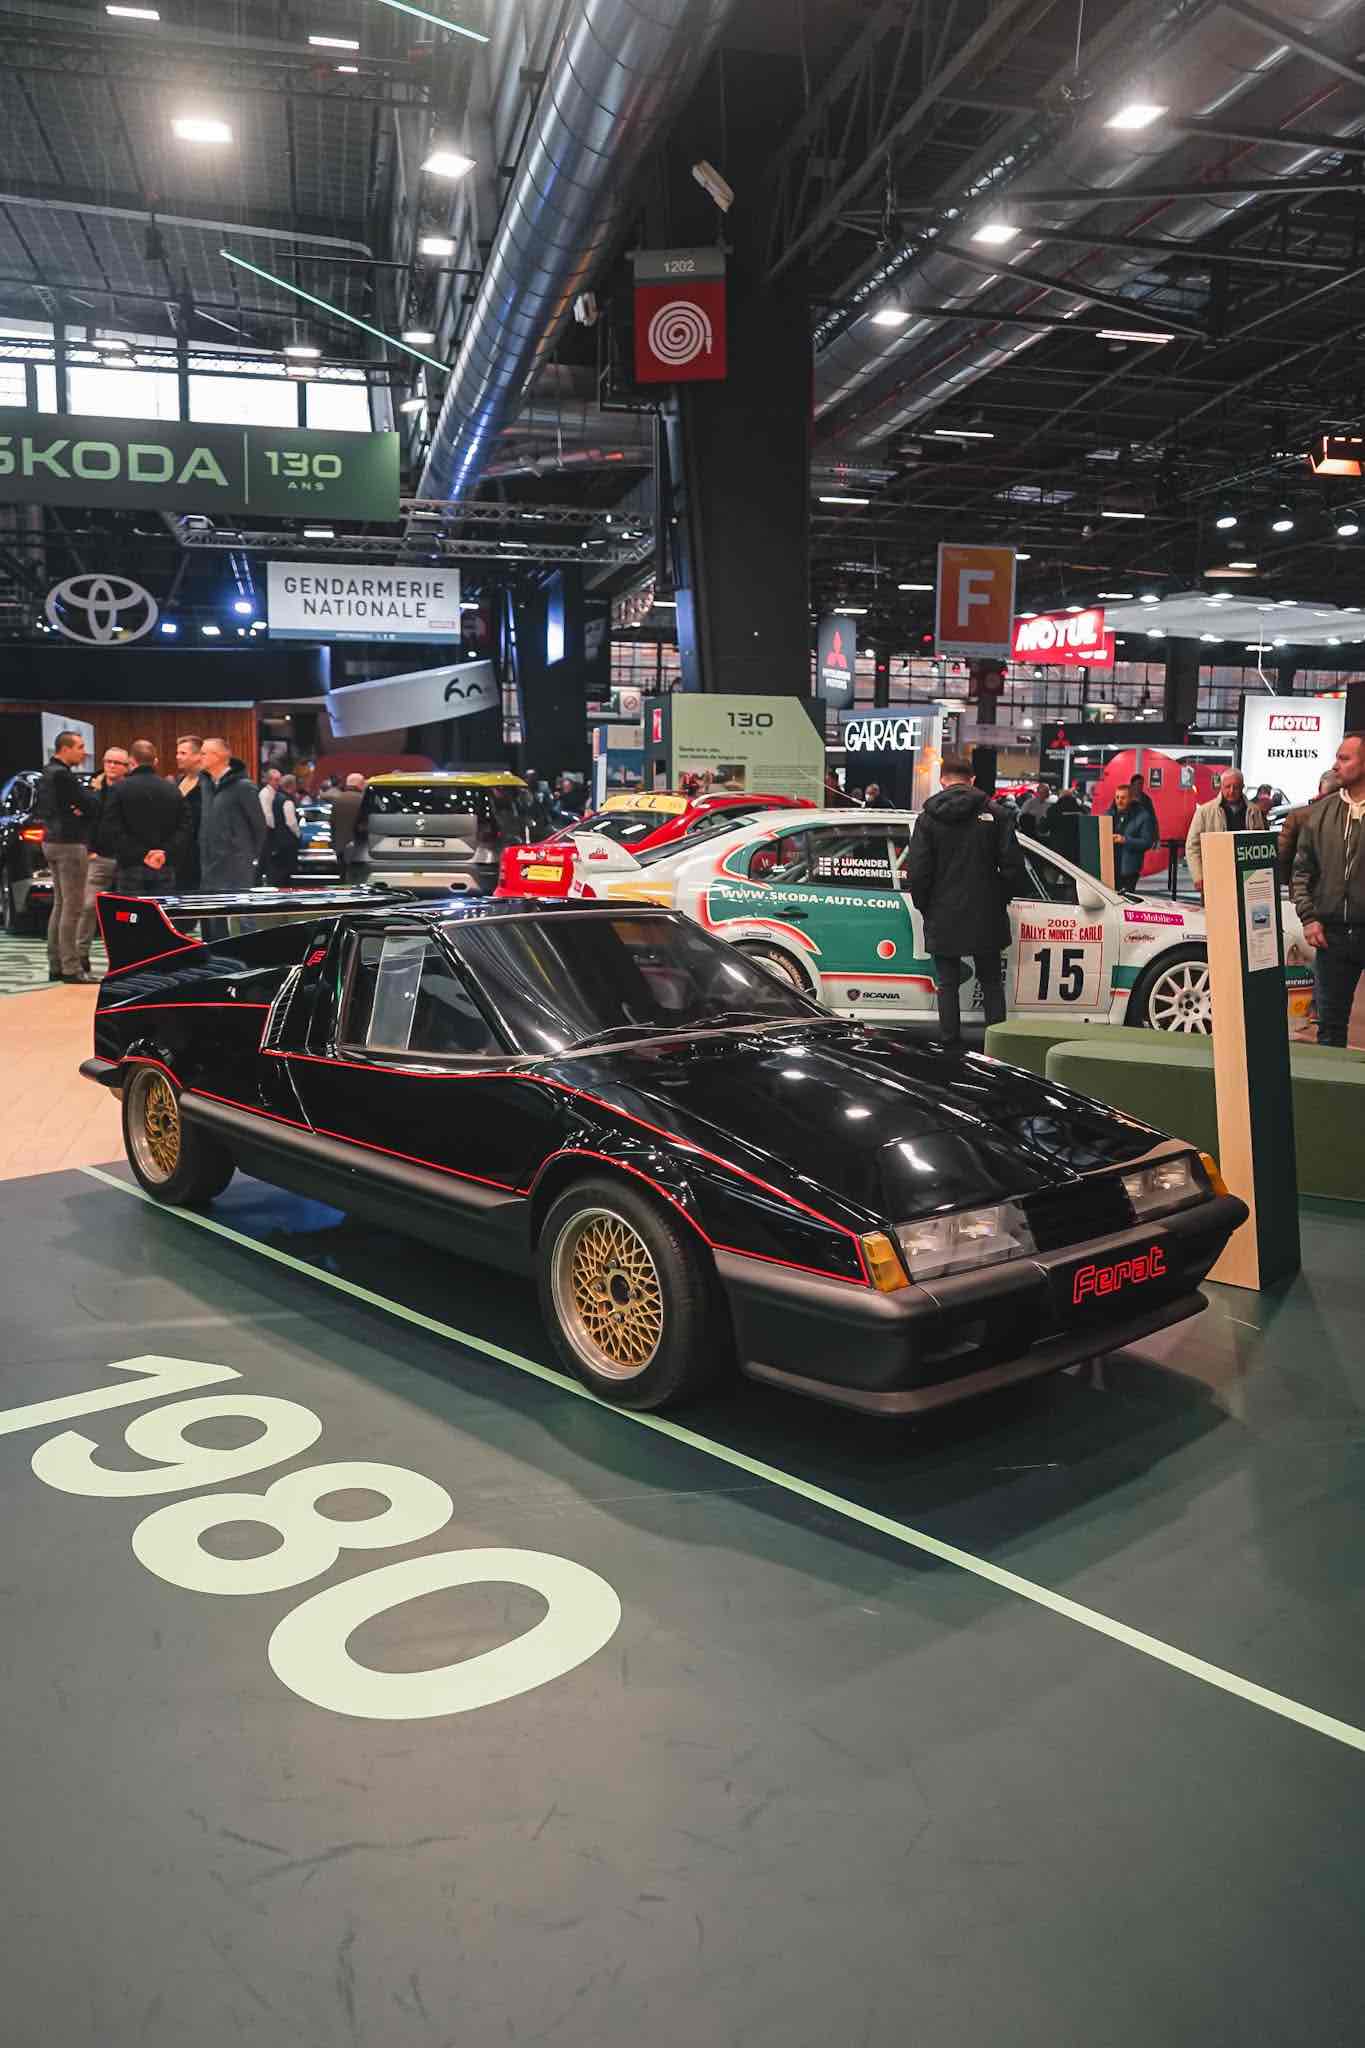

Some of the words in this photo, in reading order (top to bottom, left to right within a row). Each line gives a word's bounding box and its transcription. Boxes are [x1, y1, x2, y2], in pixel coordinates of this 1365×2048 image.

[664, 260, 696, 272] 1202
[265, 451, 342, 479] 130
[287, 481, 325, 491] ANS
[284, 577, 445, 599] GENDARMERIE
[957, 569, 995, 627] F
[303, 599, 428, 618] NATIONALE
[1015, 614, 1098, 652] MOTUL
[728, 712, 774, 727] 130
[1270, 716, 1319, 731] MOTUL
[845, 719, 922, 752] GARAGE
[1267, 748, 1319, 759] BRABUS
[841, 858, 889, 868] LUKANDER
[1020, 923, 1047, 940] RALLYE
[1048, 919, 1077, 928] 2003
[1034, 948, 1085, 1001] 15
[862, 991, 901, 1000] SCANIA
[1072, 1246, 1168, 1303] Ferat
[0, 1355, 622, 1720] 1980
